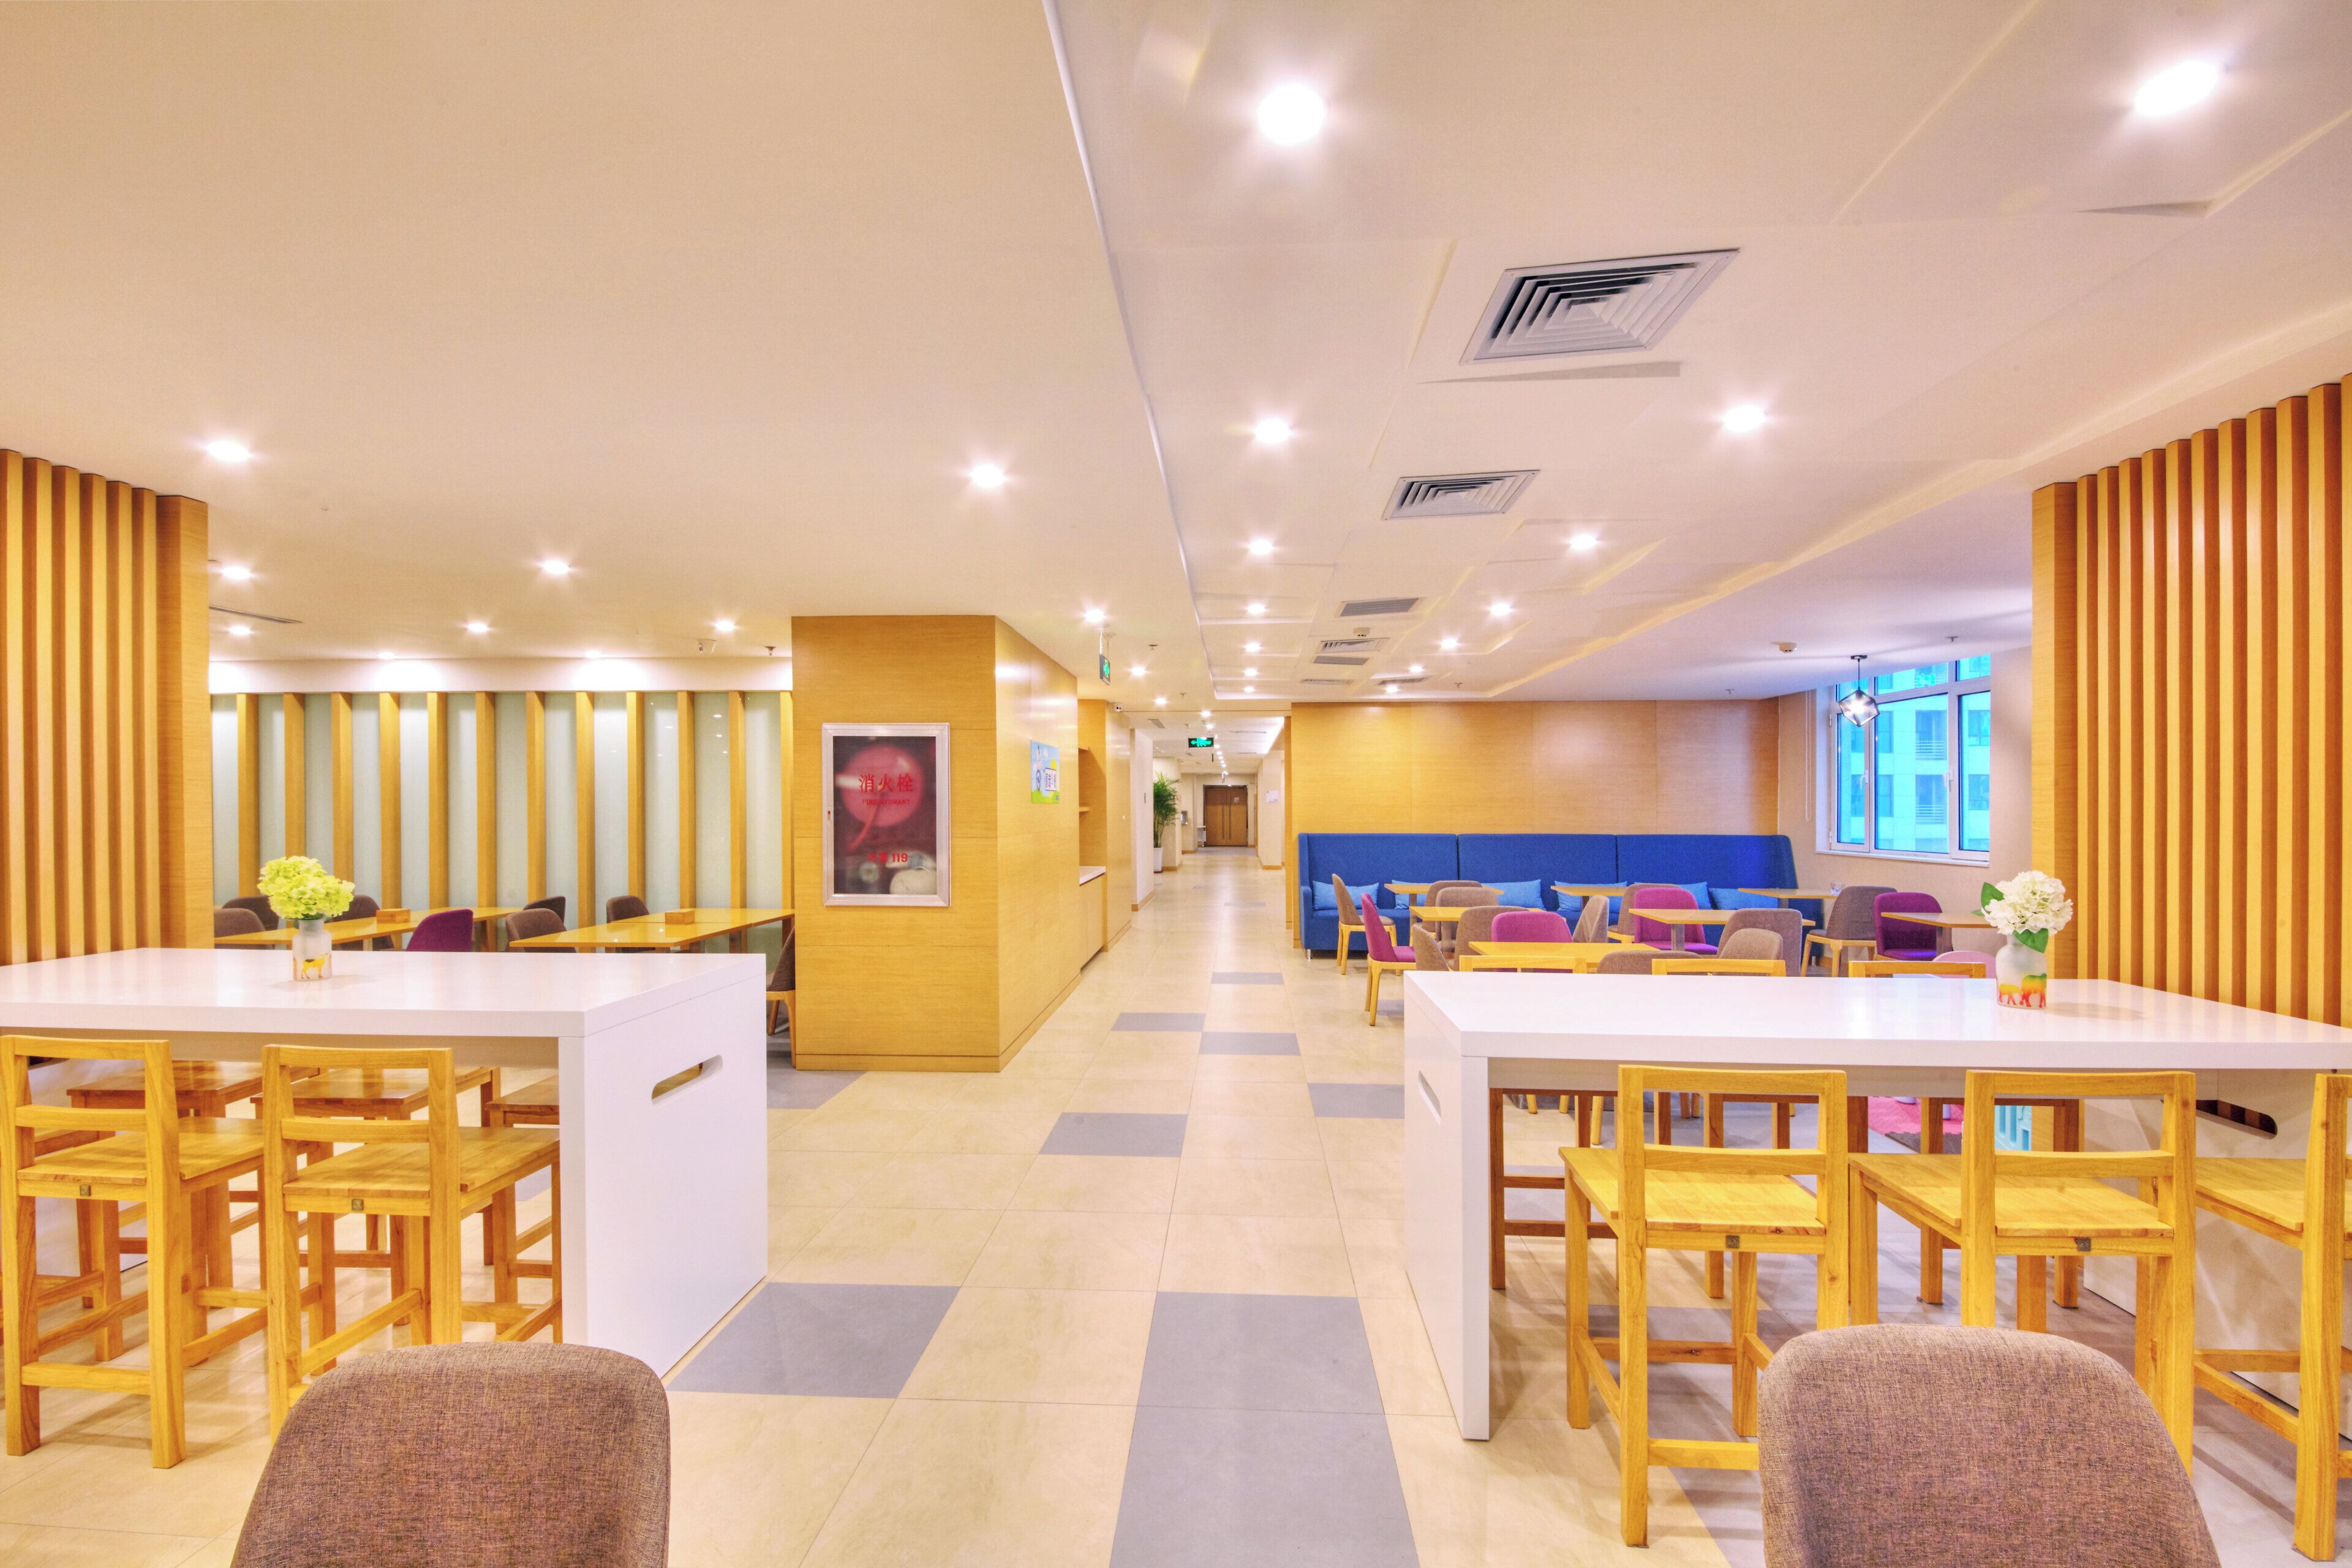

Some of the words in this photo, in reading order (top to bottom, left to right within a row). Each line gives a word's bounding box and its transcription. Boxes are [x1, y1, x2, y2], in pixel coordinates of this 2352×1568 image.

[859, 773, 913, 793] 消火栓
[892, 852, 908, 862] 119
